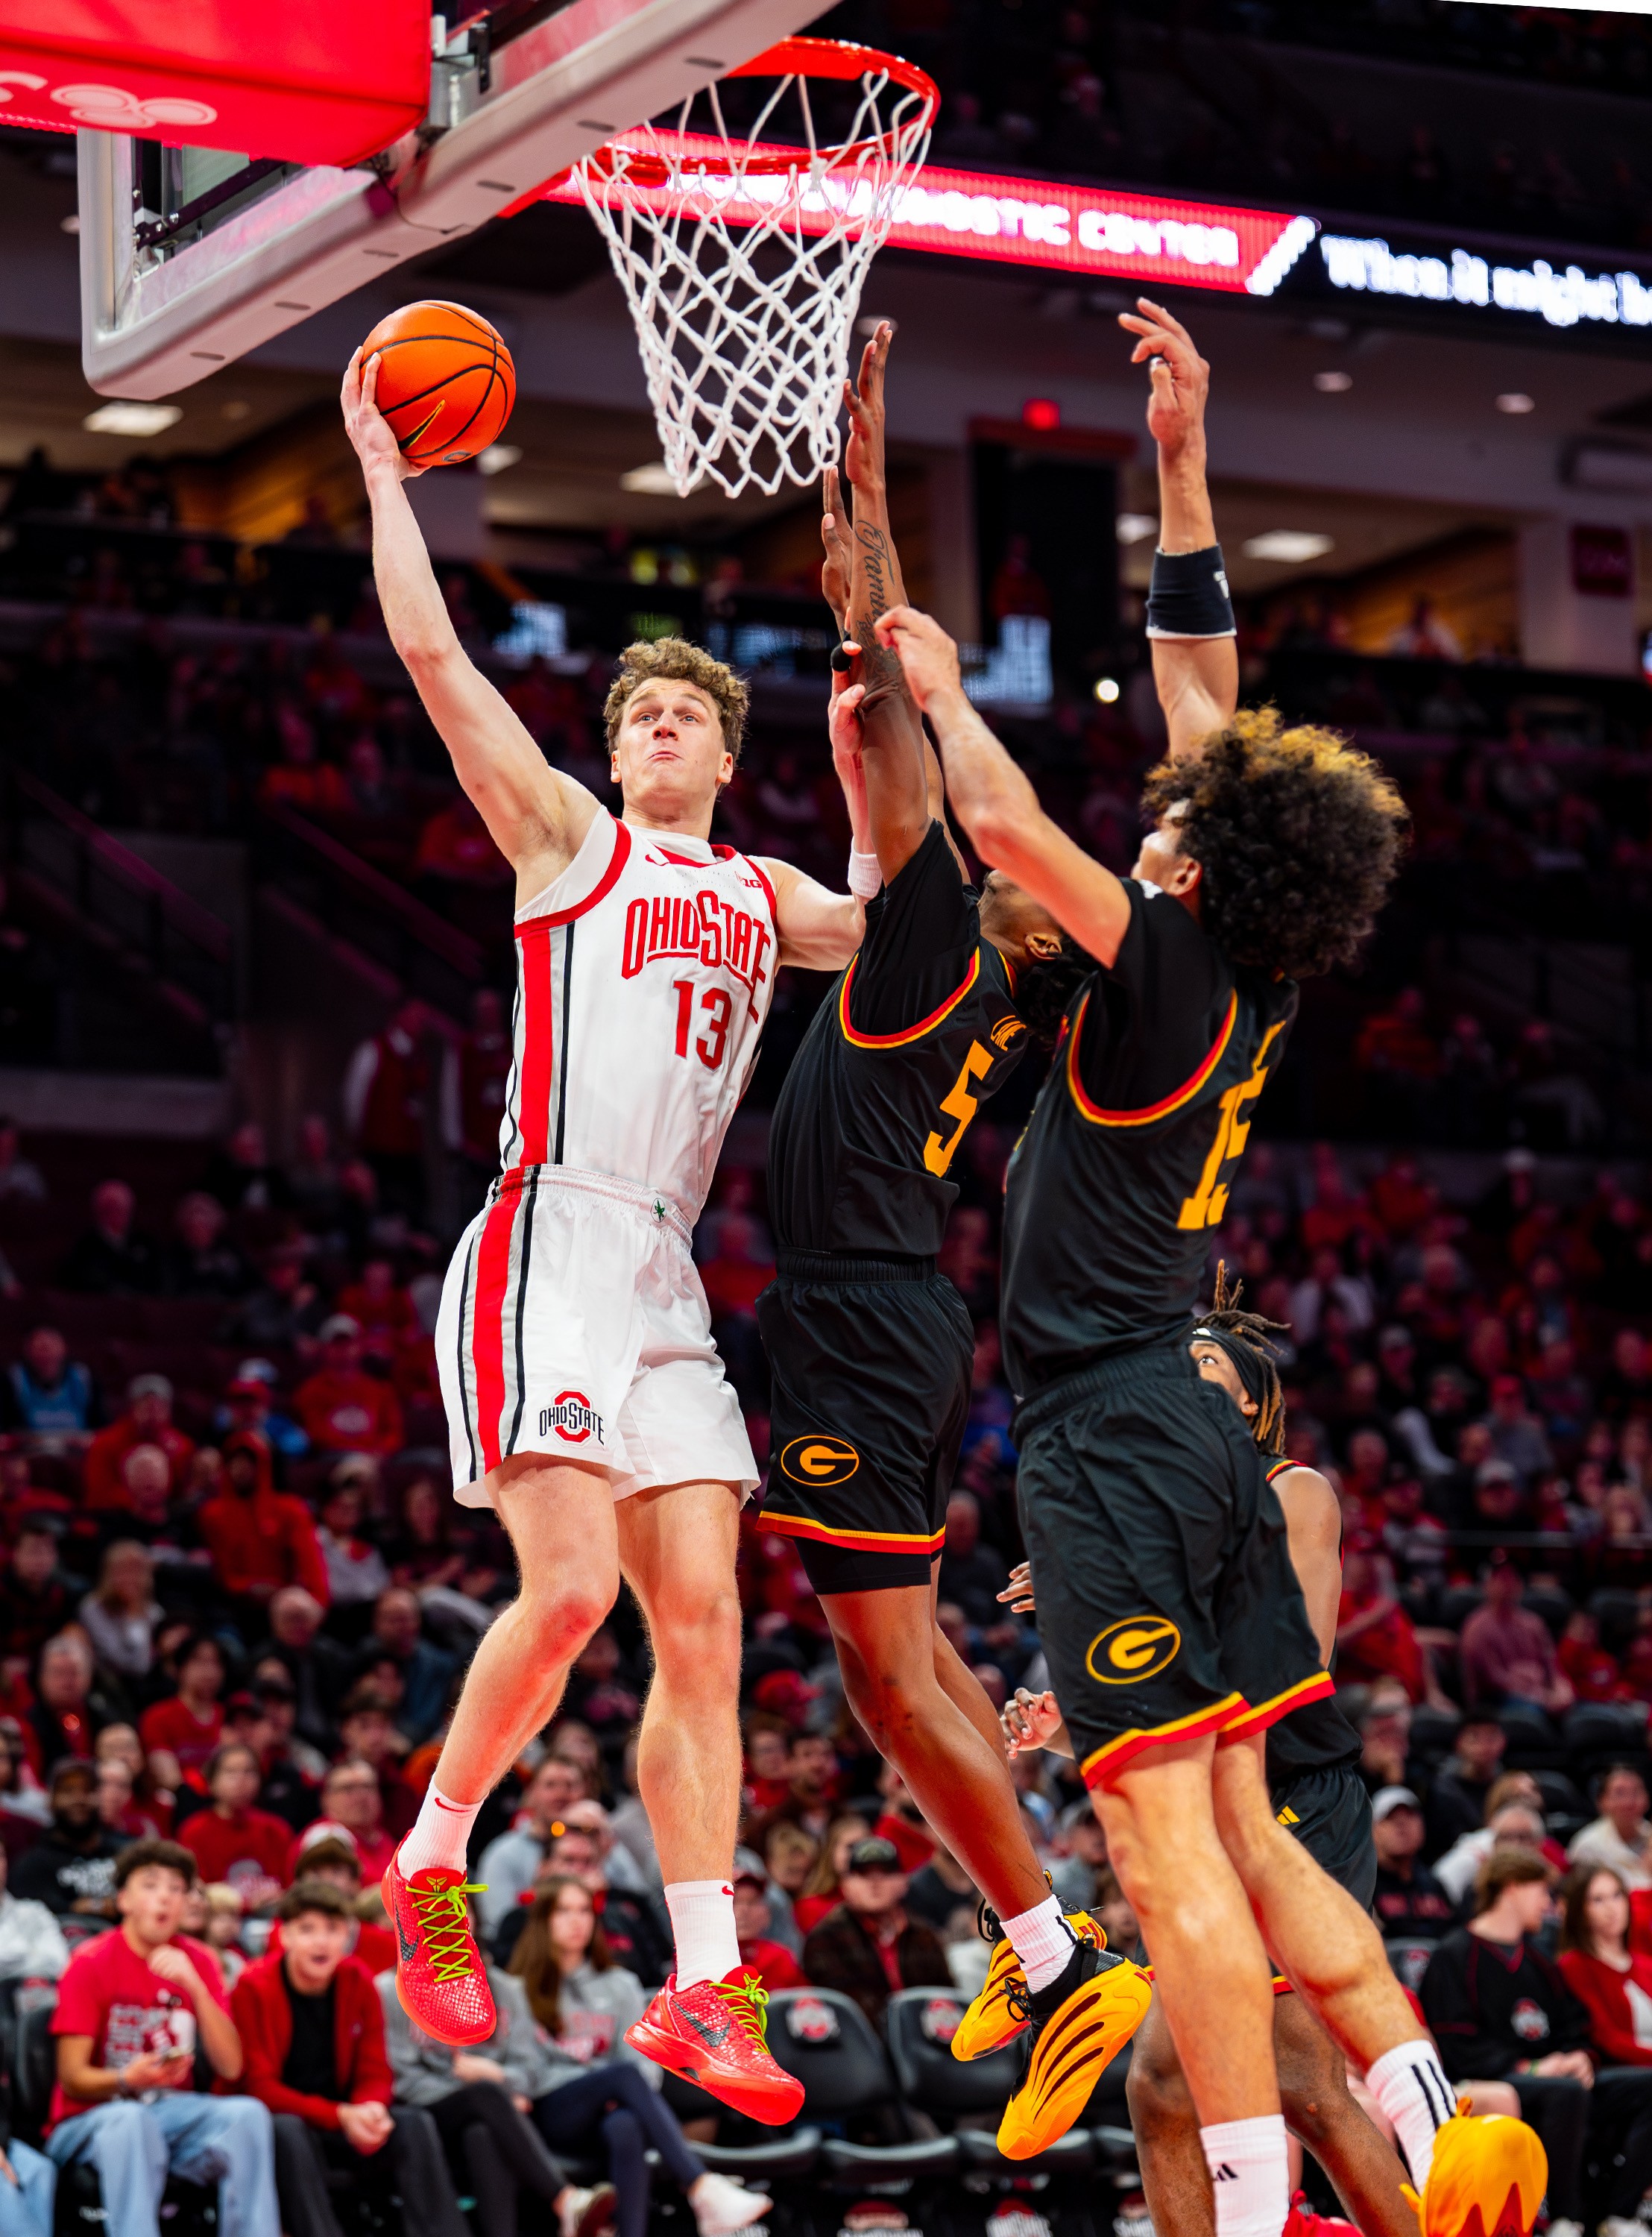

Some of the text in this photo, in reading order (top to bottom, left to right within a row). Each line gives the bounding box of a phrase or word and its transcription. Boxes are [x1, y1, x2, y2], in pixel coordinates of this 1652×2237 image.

[1078, 208, 1239, 268] CENTER
[1320, 234, 1451, 301] When
[1492, 259, 1618, 327] might
[673, 981, 732, 1071] 13
[924, 1039, 994, 1177] 5
